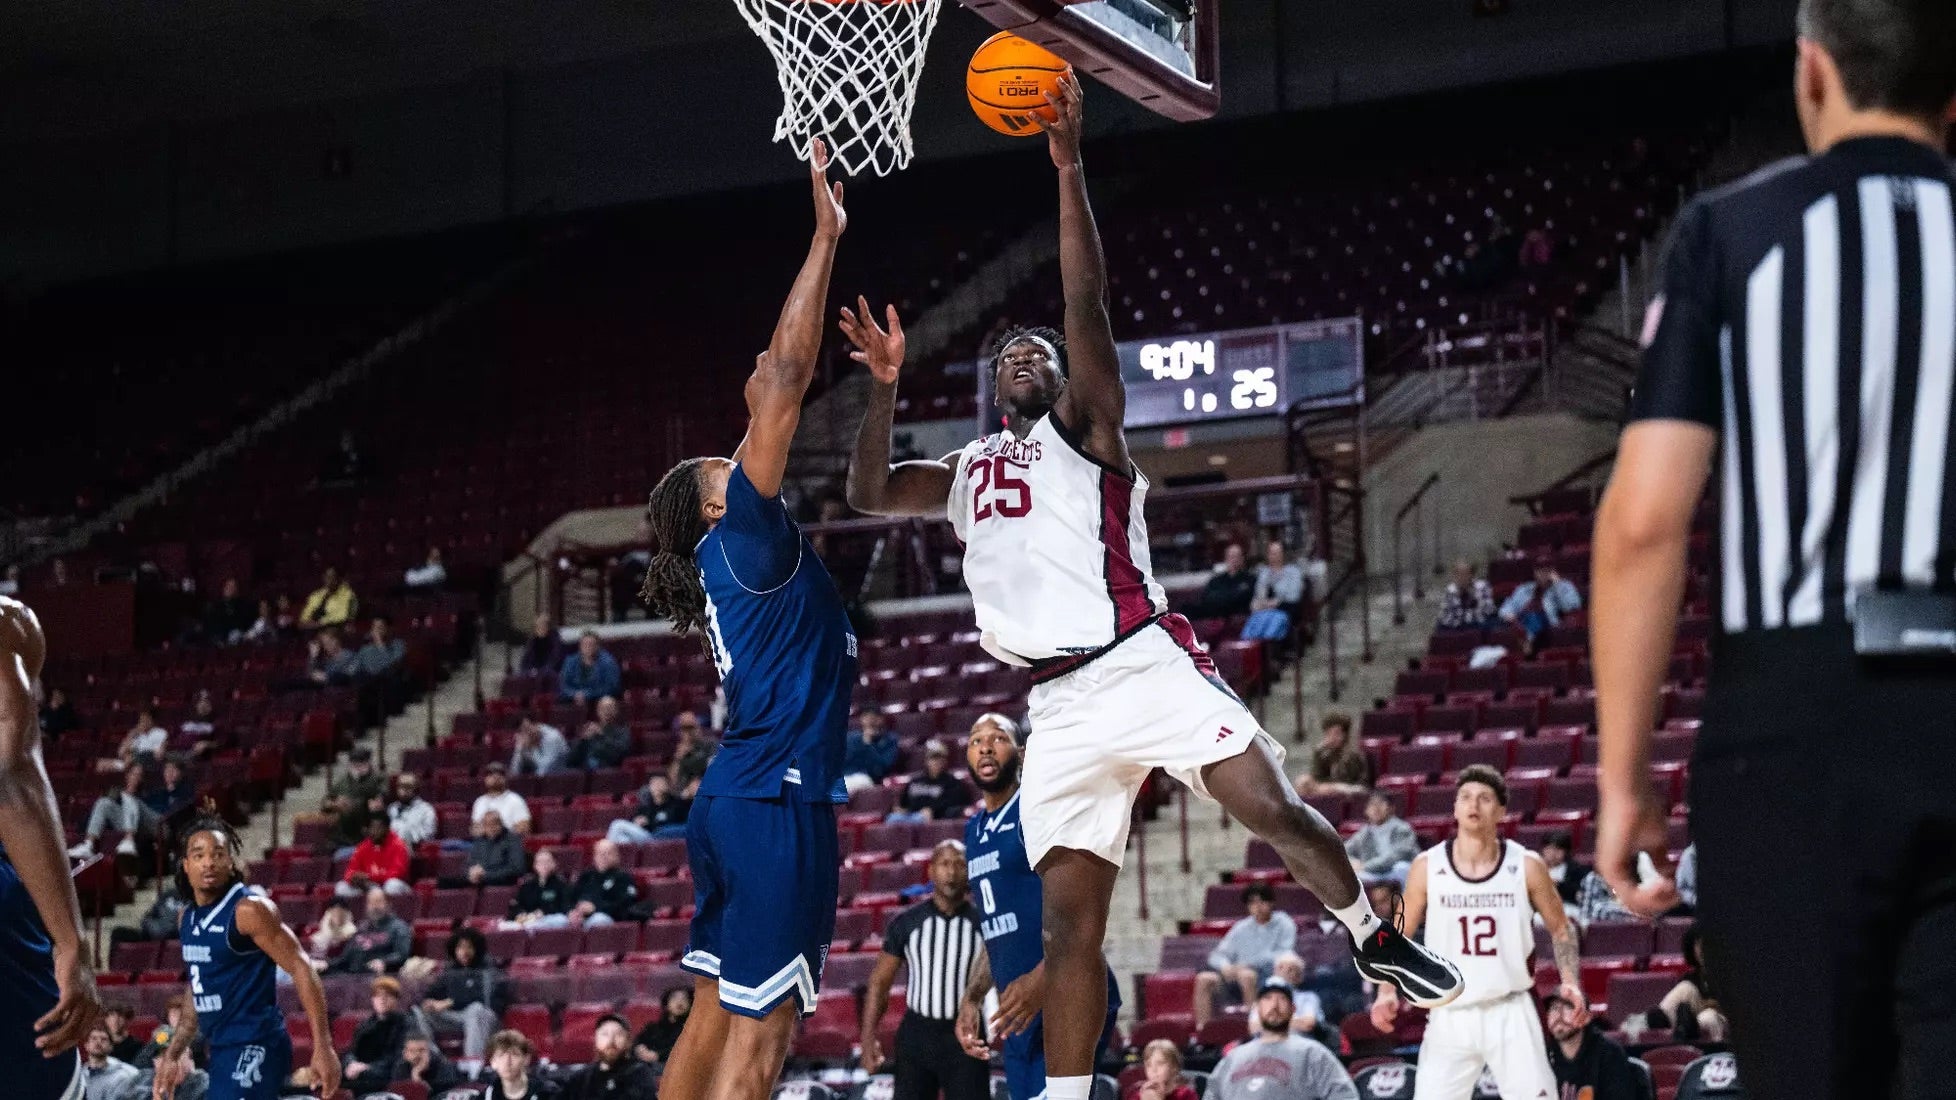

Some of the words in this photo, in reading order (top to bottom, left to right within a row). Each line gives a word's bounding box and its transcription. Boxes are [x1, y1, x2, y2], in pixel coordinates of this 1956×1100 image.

[1140, 340, 1215, 380] 9:04
[1231, 367, 1277, 410] 25
[967, 455, 1033, 524] 25
[979, 878, 996, 915] 0
[1440, 893, 1516, 909] MASSACHUSETTS
[1458, 915, 1498, 957] 12
[190, 964, 204, 994] 2
